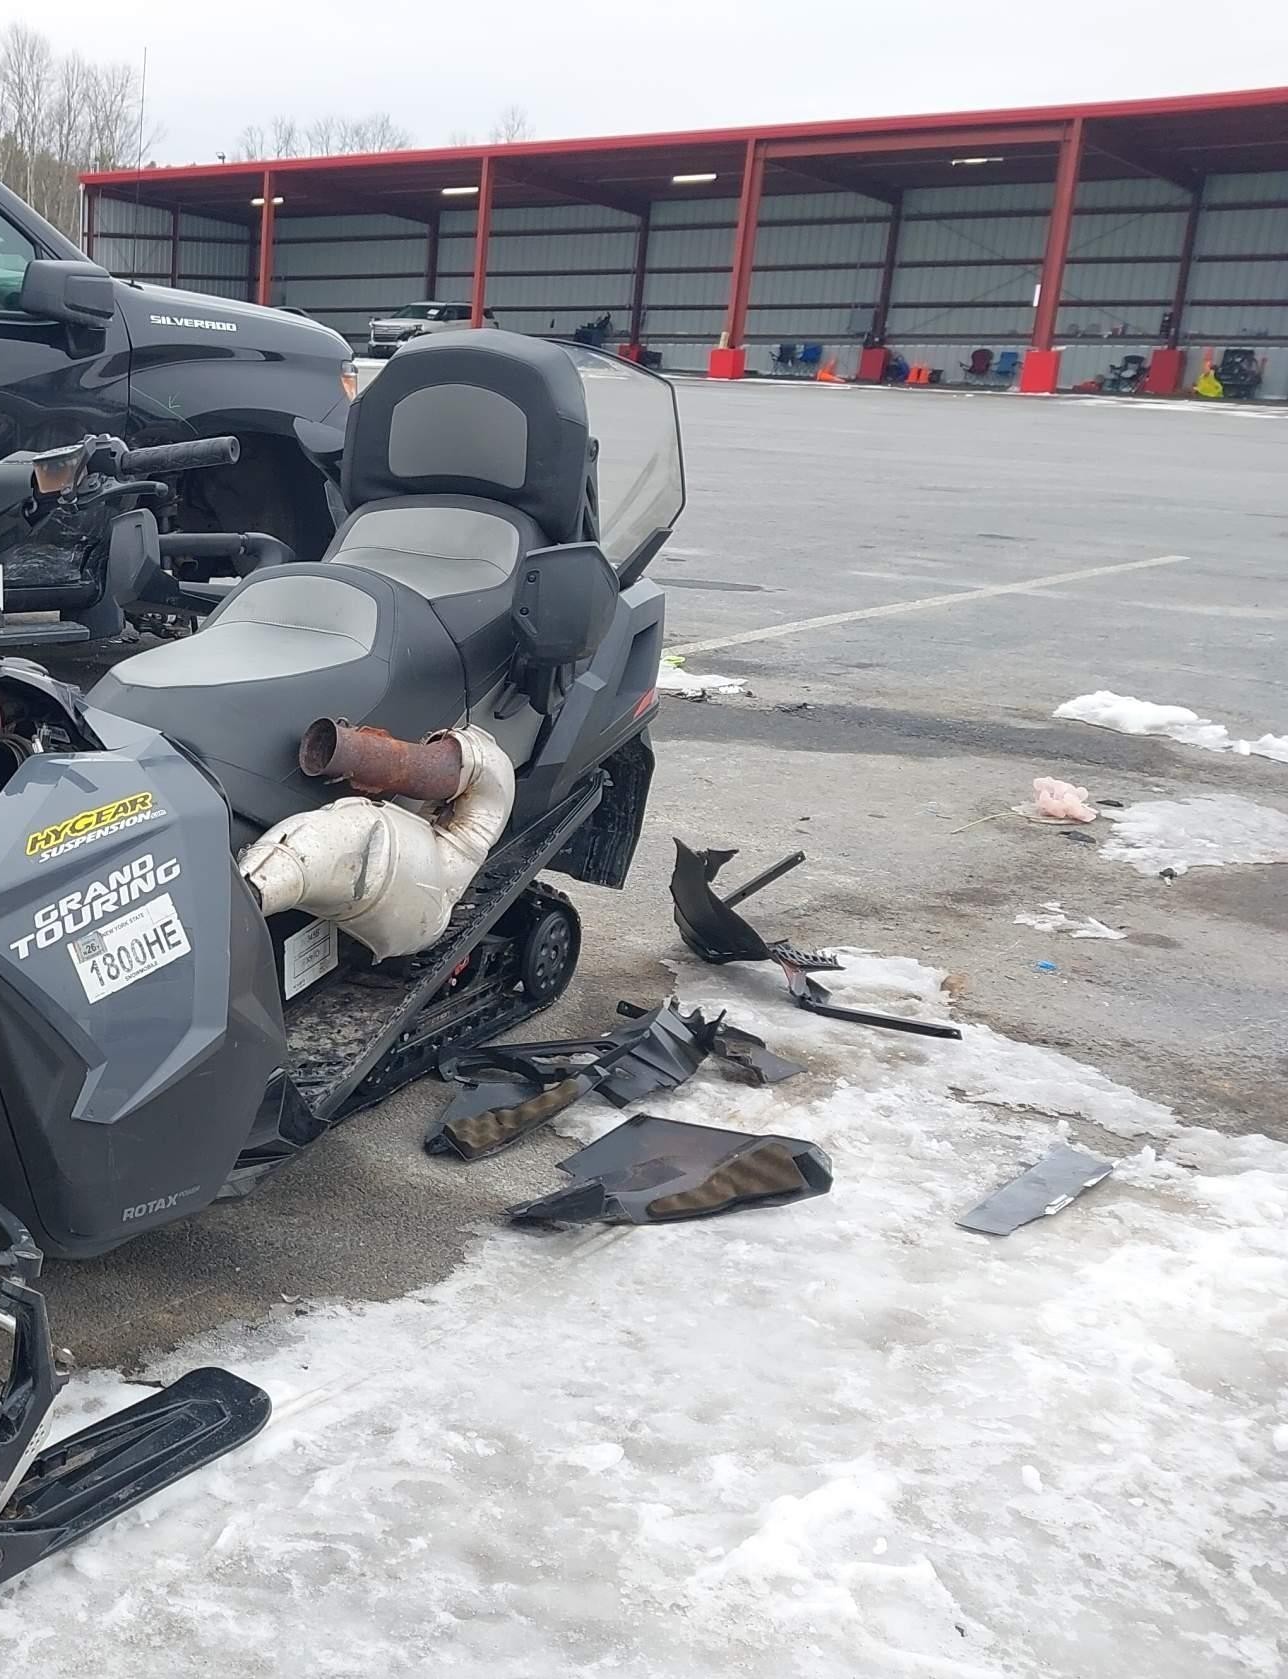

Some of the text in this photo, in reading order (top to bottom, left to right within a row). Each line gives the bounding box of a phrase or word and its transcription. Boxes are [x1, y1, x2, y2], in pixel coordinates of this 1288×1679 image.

[150, 315, 237, 332] SILVERADO
[26, 792, 153, 855] HYGEAR
[9, 857, 181, 960] TOURING
[34, 854, 154, 929] GRAND
[115, 920, 129, 933] YORK
[130, 912, 145, 924] STATE
[91, 919, 182, 986] 1800HE
[125, 961, 159, 981] SNOWMOBILE
[122, 1192, 179, 1221] ROTAX
